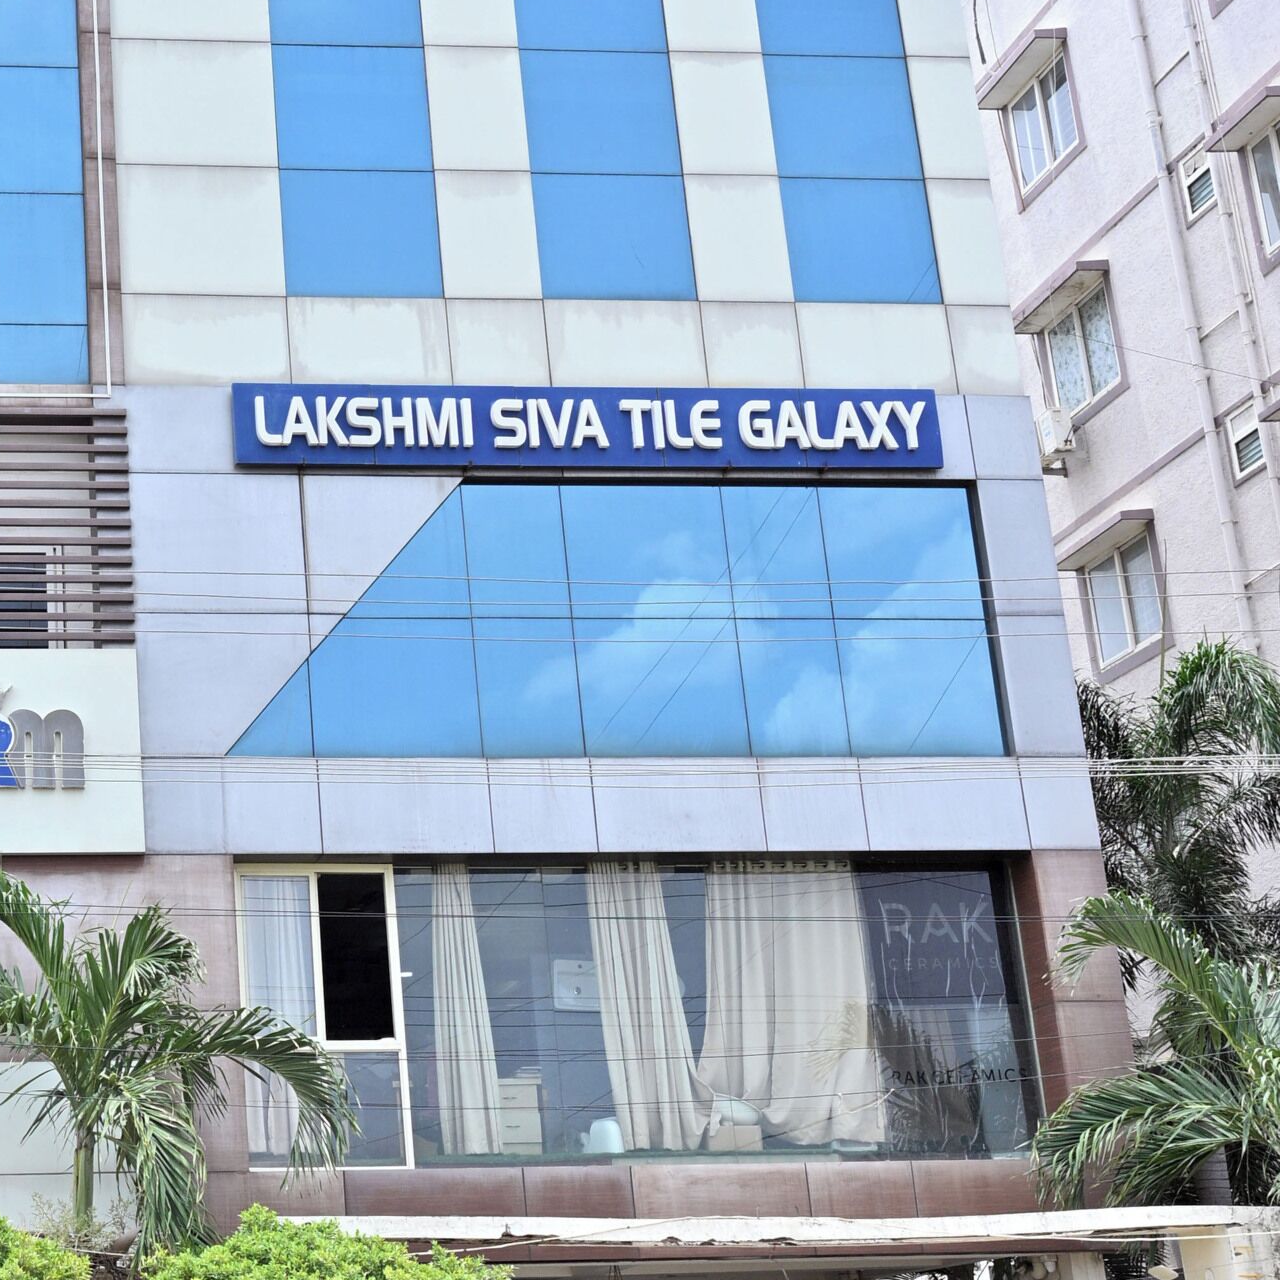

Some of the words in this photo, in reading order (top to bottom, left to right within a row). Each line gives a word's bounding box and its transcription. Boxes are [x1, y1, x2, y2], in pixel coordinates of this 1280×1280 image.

[254, 394, 474, 450] LAKSHMI
[493, 398, 610, 451] SIVA
[619, 398, 721, 451] TILE
[738, 399, 926, 452] GALAXY
[879, 901, 995, 946] RAK
